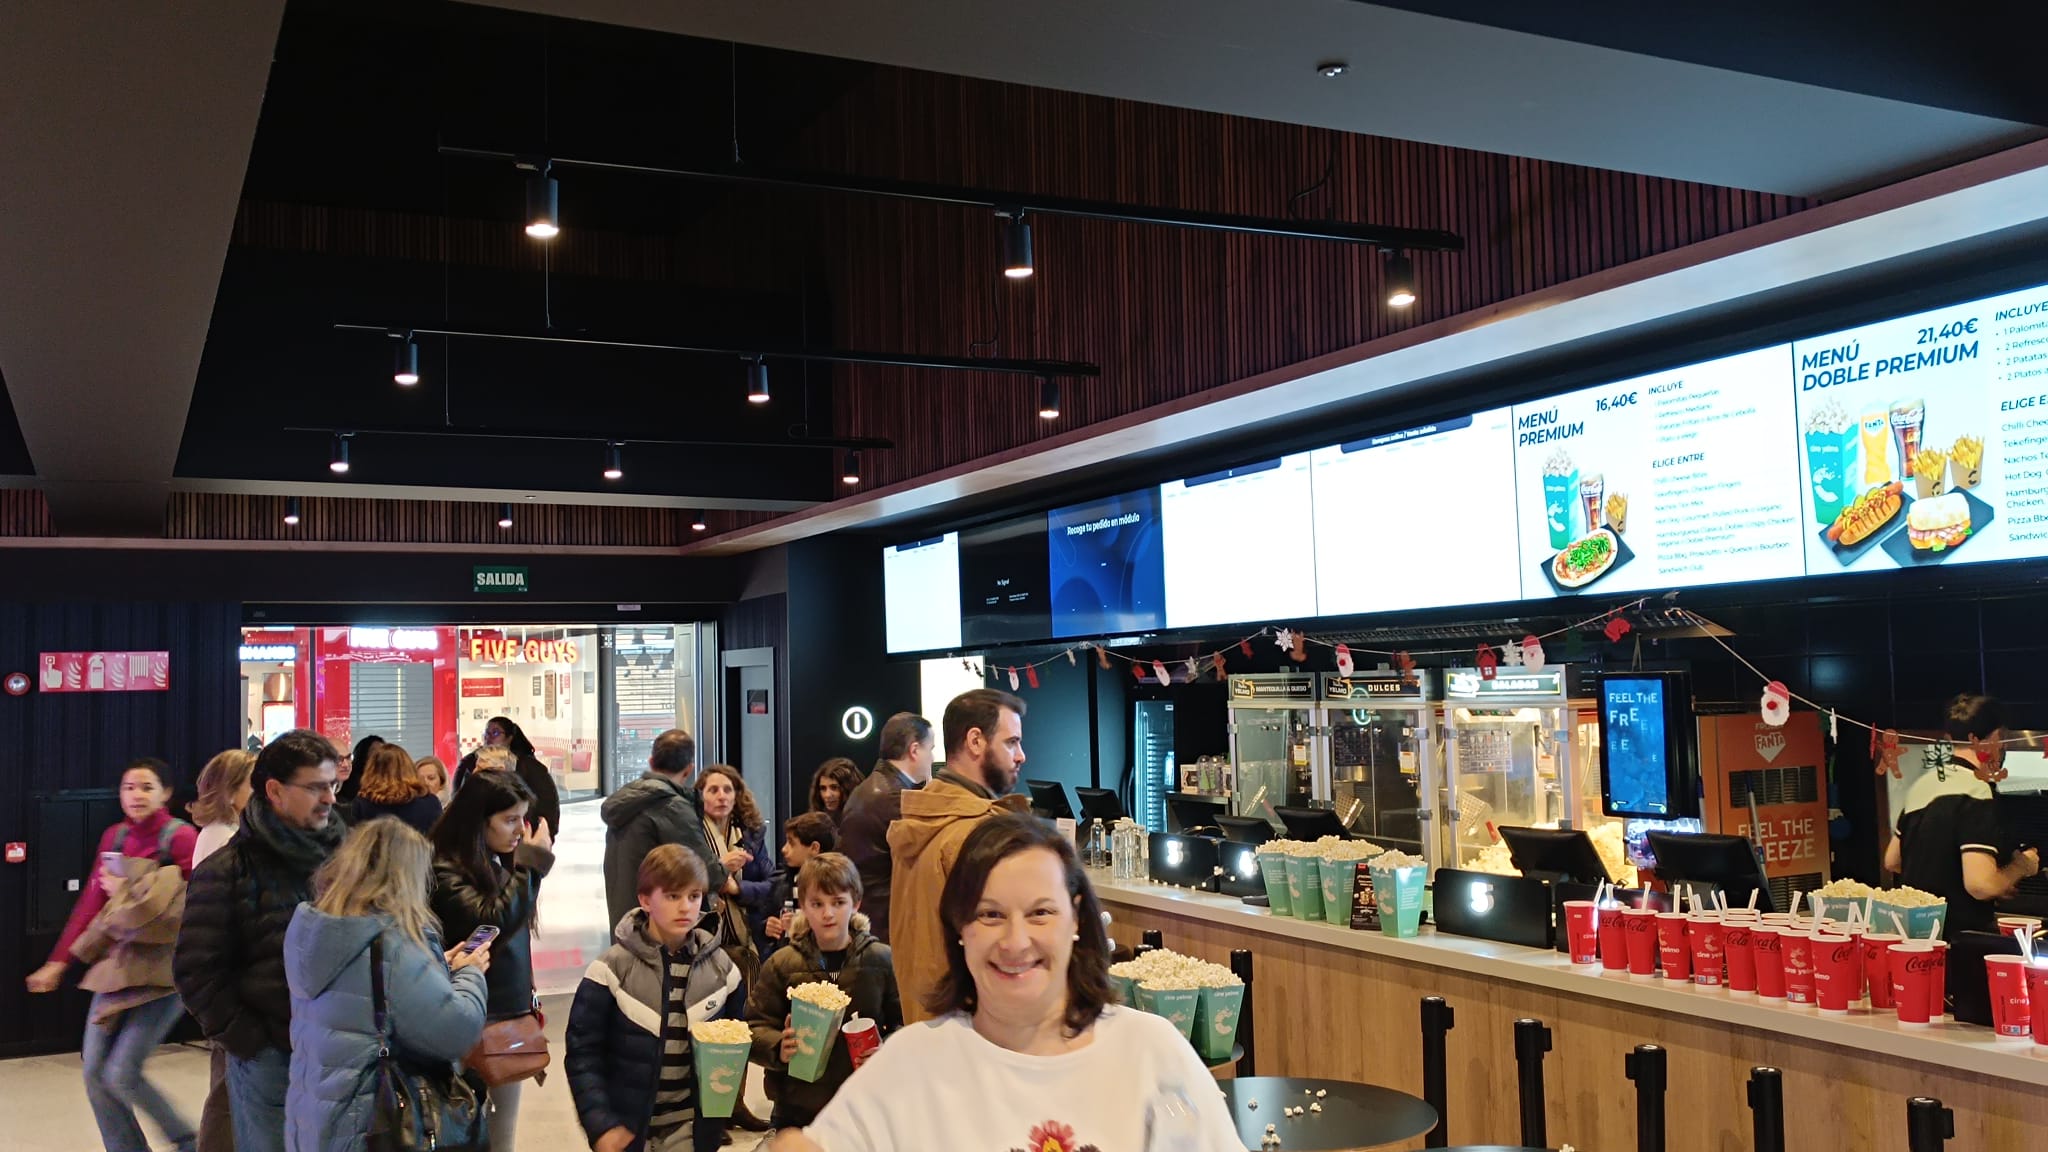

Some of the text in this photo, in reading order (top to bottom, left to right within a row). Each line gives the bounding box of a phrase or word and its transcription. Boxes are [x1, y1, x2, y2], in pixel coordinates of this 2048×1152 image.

[1995, 301, 2048, 321] INCLUYE
[1916, 317, 1978, 345] 21,40€
[1802, 338, 1860, 371] MENÚ
[1803, 340, 1979, 391] DOBLE PREMIUM
[1648, 380, 1683, 395] INCLUYE
[1595, 391, 1638, 413] 16,40€
[2001, 396, 2036, 411] ELIGE
[1518, 405, 1559, 430] MENÚ
[1519, 421, 1584, 447] PREMIUM
[1652, 452, 1705, 469] ELIGE ENTRE
[2005, 473, 2021, 481] Hot
[2023, 470, 2042, 481] Dog
[1092, 518, 1111, 533] pedido
[2008, 516, 2032, 525] Pizza
[476, 572, 525, 586] SALIDA
[469, 638, 579, 664] FIVE GUYS
[1367, 683, 1401, 692] DULCES
[1609, 692, 1658, 704] FEEL THE
[1755, 733, 1786, 750] FANTA
[1781, 818, 1814, 837] THE
[1766, 838, 1815, 862] EEZE
[1470, 881, 1489, 913] 5
